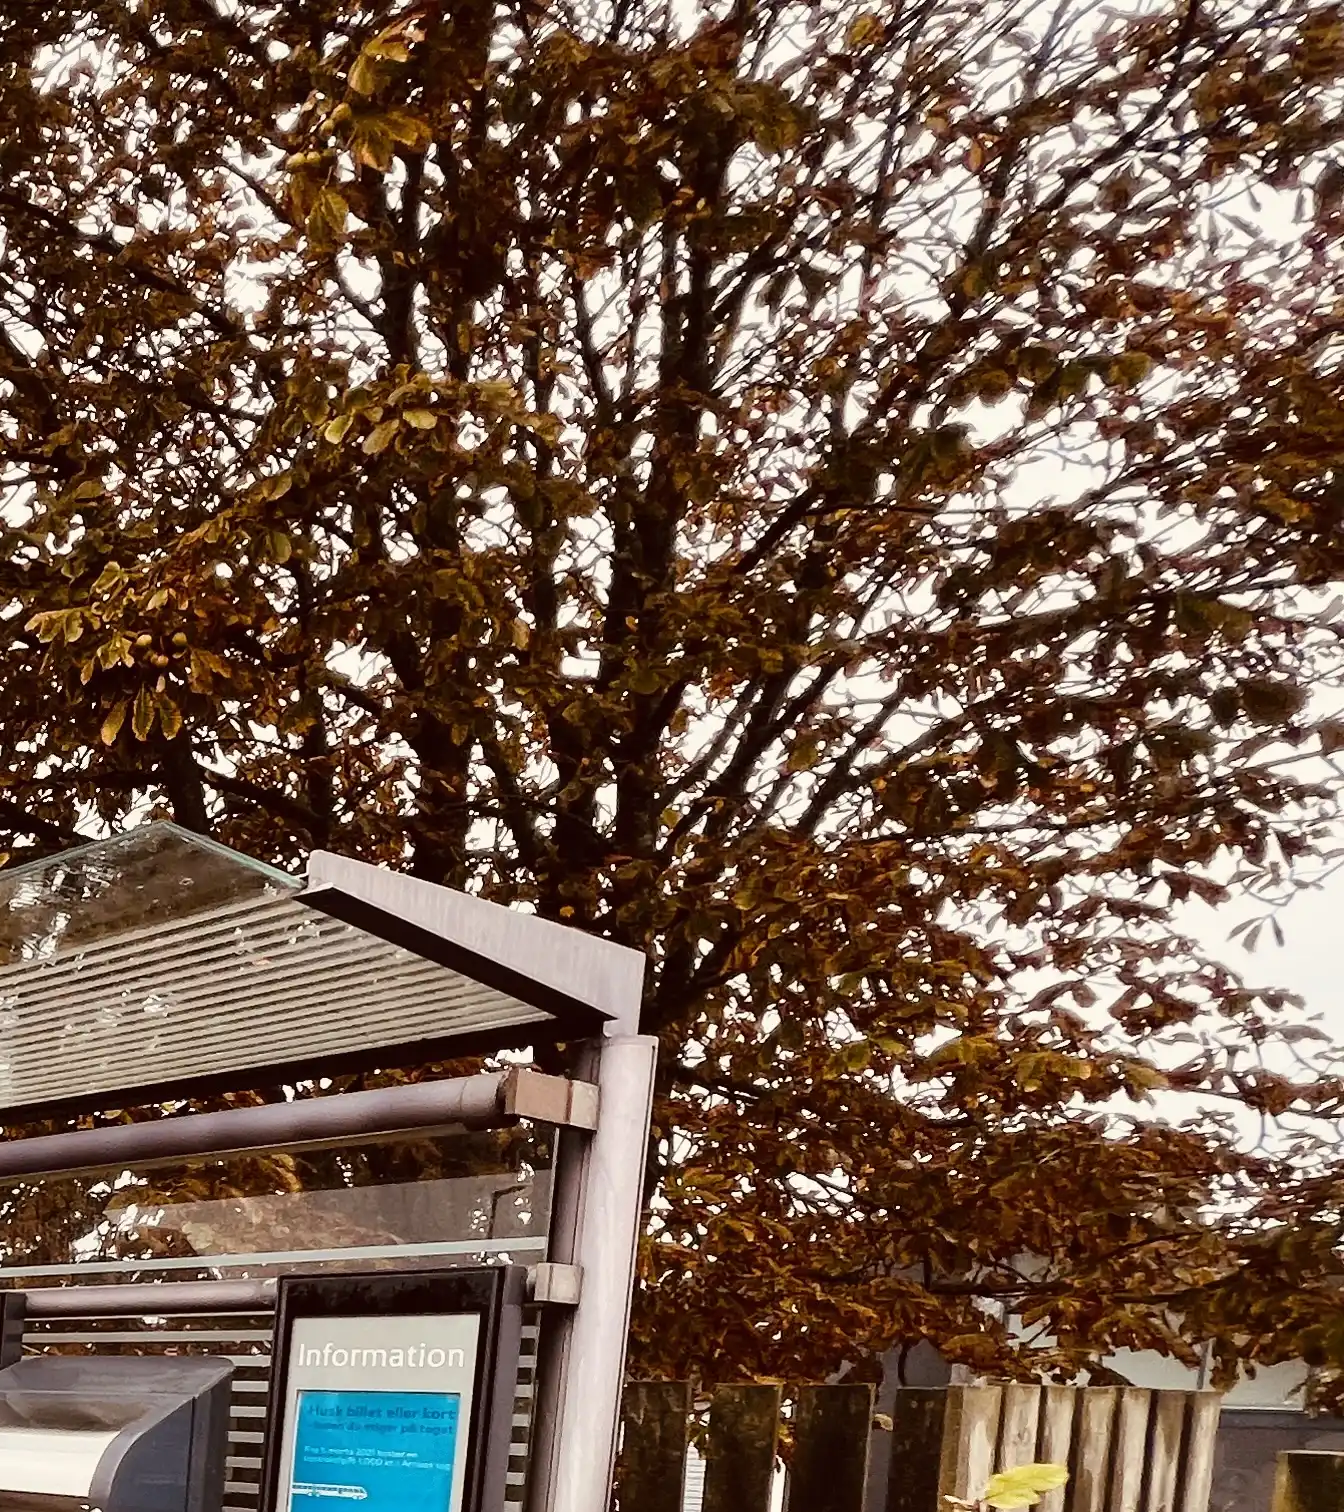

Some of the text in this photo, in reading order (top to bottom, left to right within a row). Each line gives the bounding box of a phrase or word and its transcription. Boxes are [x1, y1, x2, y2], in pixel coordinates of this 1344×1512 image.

[298, 1342, 465, 1368] Information
[346, 1405, 382, 1418] billet
[386, 1406, 418, 1419] eller
[422, 1407, 456, 1420] kort
